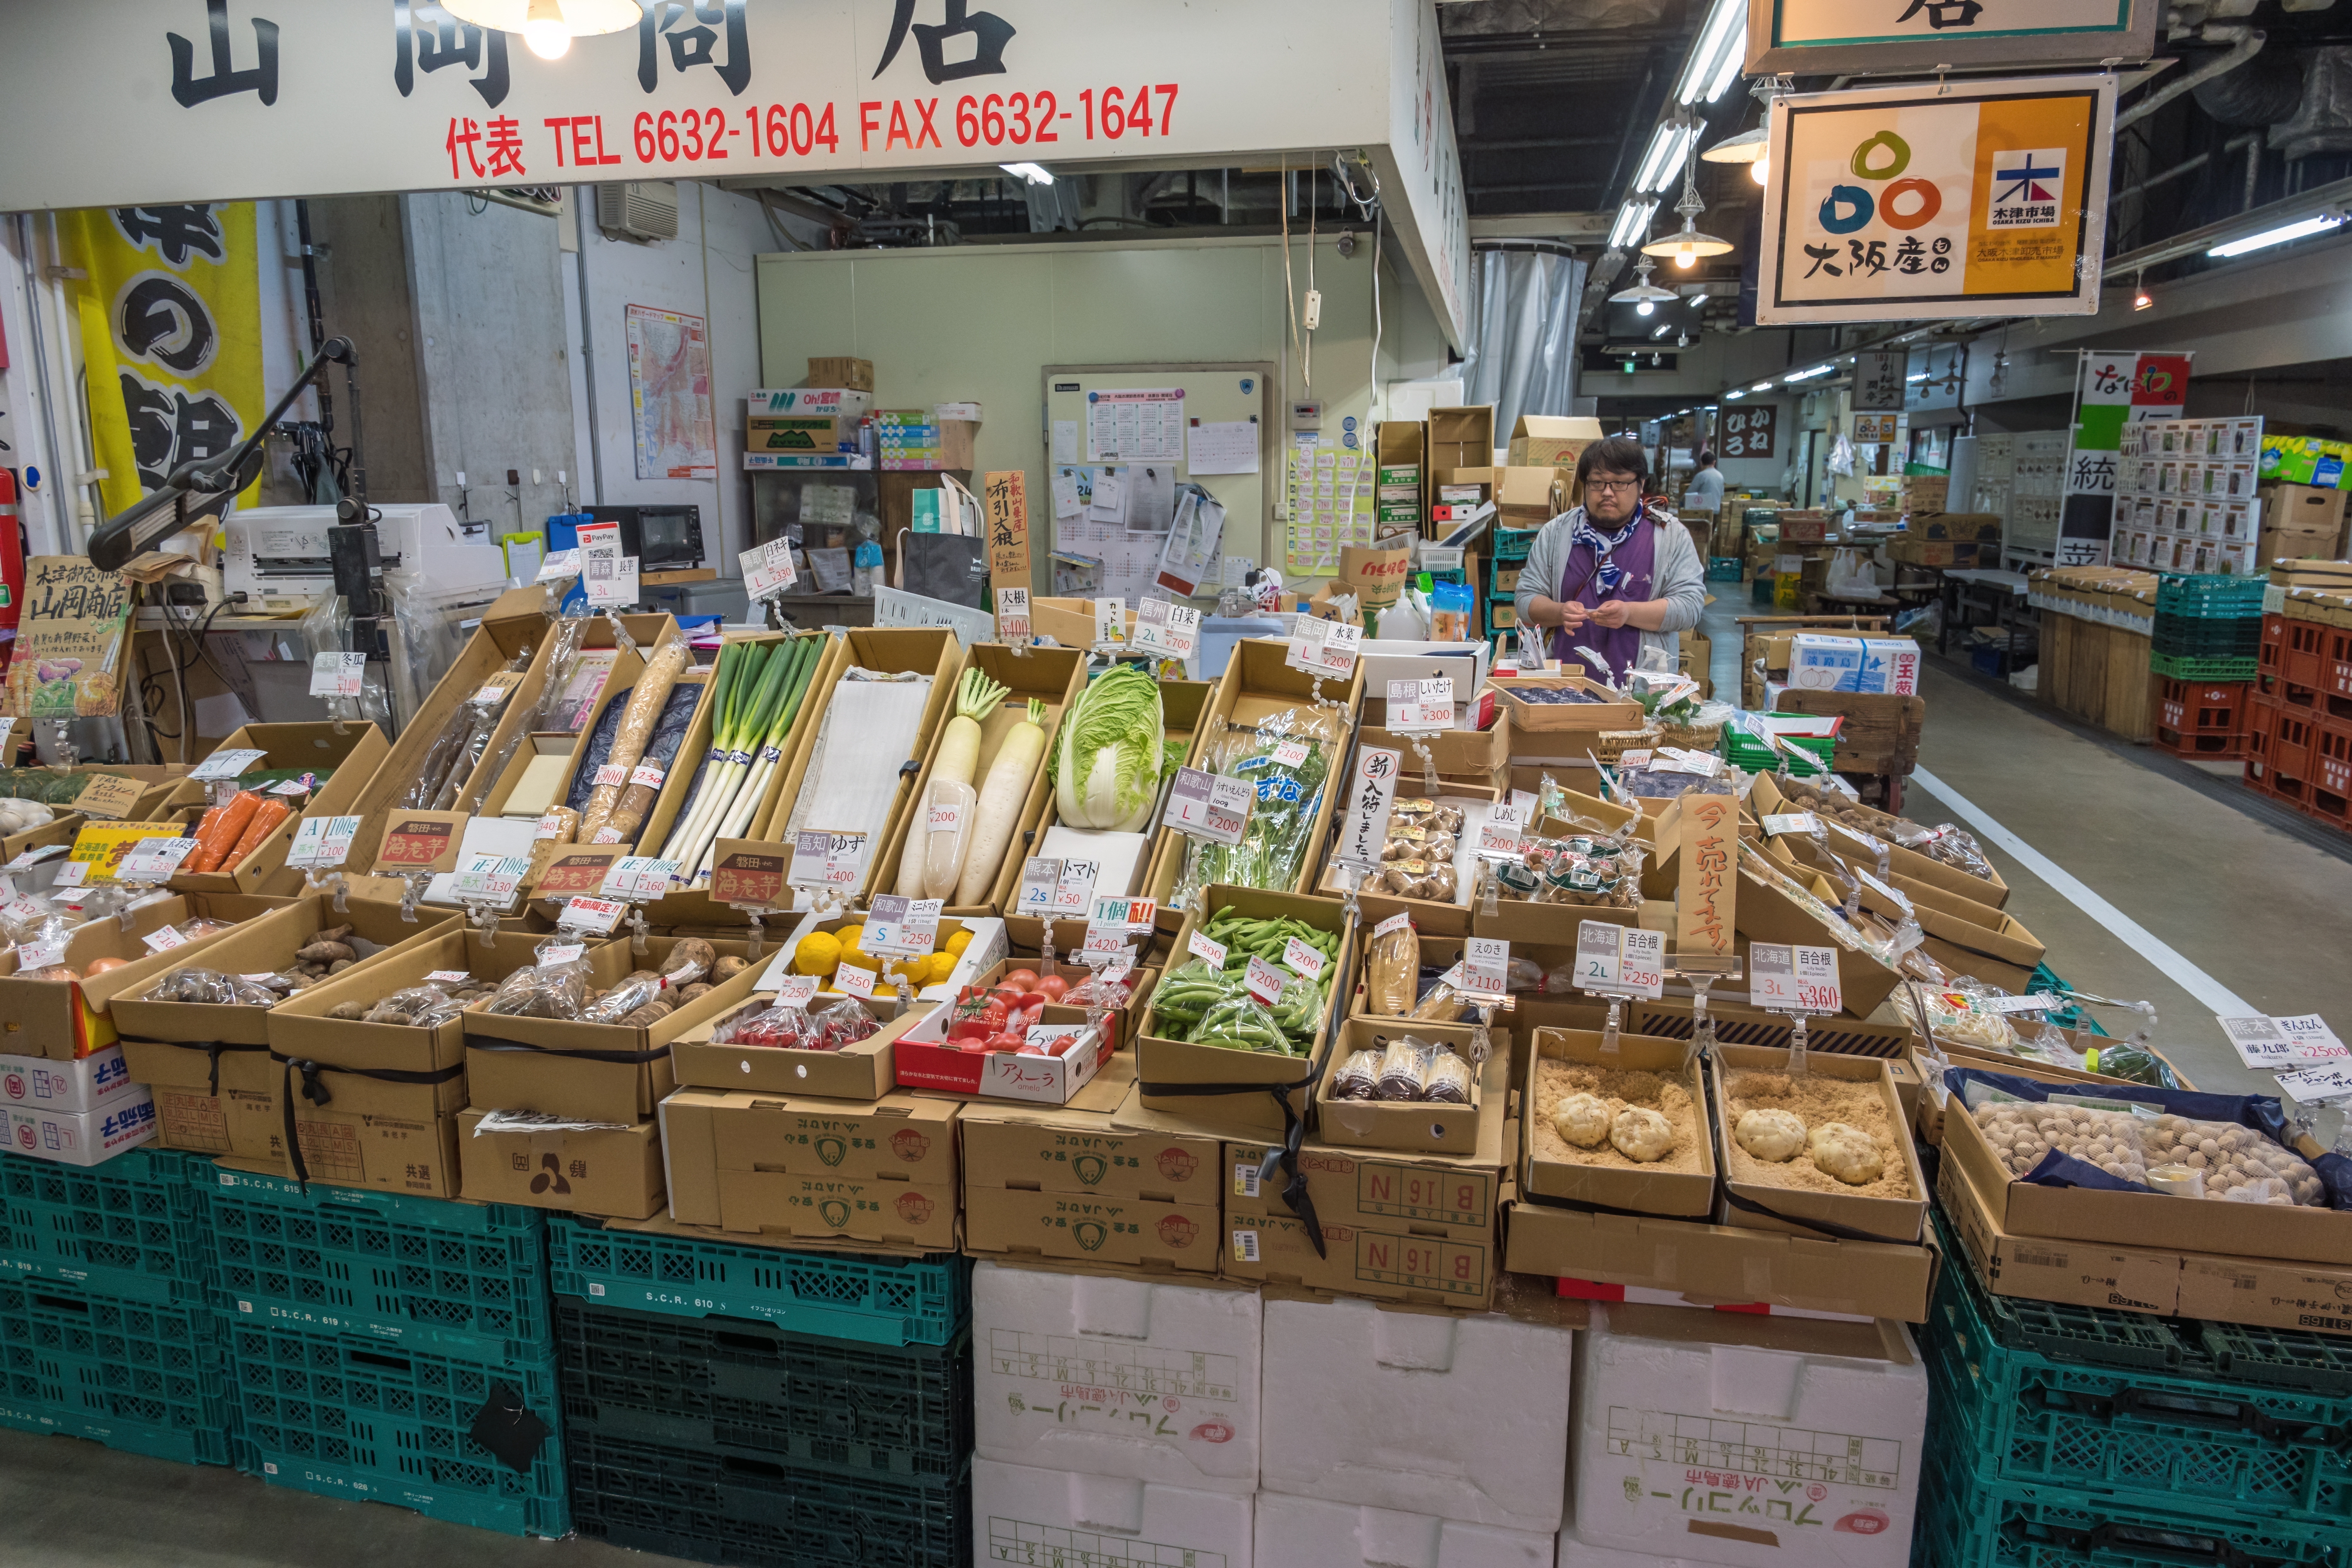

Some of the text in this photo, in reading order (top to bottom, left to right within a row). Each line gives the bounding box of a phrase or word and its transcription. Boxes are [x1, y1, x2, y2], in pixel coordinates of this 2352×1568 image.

[446, 84, 1178, 179] 代表 TEL 6632-1604 FAX 6632-1647
[1994, 205, 2055, 218] 木津市場
[1977, 246, 2064, 257] 大阪木津卸売市場
[2073, 456, 2116, 490] 統
[1008, 473, 1025, 533] 和歌山県産
[989, 479, 1023, 548] 布引大根
[766, 537, 787, 557] 白ネギ
[619, 560, 633, 572] 長芋
[743, 551, 763, 569] 鳥取
[590, 561, 611, 576] 青森
[597, 585, 608, 595] 3L
[755, 577, 763, 587] L
[31, 583, 126, 620] 山岡商店
[1001, 590, 1025, 604] 大根
[1142, 601, 1167, 620] 信州
[1171, 605, 1196, 625] 白菜
[1002, 620, 1030, 637] ¥400-
[1143, 628, 1156, 642] 2L
[1298, 617, 1326, 638] 福岡
[1334, 626, 1355, 640] 水菜
[1166, 638, 1192, 649] ¥700-
[342, 653, 364, 665] 冬瓜
[1302, 646, 1309, 659] L
[316, 655, 337, 668] 愛知
[1324, 656, 1353, 668] ¥200-
[1389, 682, 1417, 699] 島根
[1420, 680, 1452, 694] しいたけ
[1423, 708, 1453, 721] ¥300-
[1179, 771, 1211, 791] 和歌山
[1216, 781, 1251, 798] うすいえんどう
[1212, 798, 1229, 808] 100g
[1354, 755, 1389, 862] 新入荷しました。
[1182, 804, 1191, 820] L
[1494, 805, 1518, 822] しめじ
[328, 817, 358, 838] 100g
[1207, 816, 1242, 834] ¥200-
[75, 843, 109, 852] 北海道産
[166, 838, 198, 849] 玉ねぎ
[386, 836, 447, 860] 海老芋
[798, 834, 826, 851] 高知
[831, 835, 866, 854] ゆず
[1482, 836, 1516, 850] ¥200-
[321, 846, 347, 856] ¥100-
[827, 871, 857, 882] ¥400-
[1026, 860, 1056, 877] 熊本
[1062, 859, 1096, 879] トマト
[485, 882, 513, 893] ¥130-
[638, 881, 667, 891] ¥160-
[875, 898, 906, 914] 和歌山
[910, 900, 938, 912] ミニトマト
[1058, 893, 1083, 904] ¥50-
[1096, 901, 1129, 921] 1個
[875, 928, 888, 941] S
[901, 933, 935, 945] ¥250-
[1582, 928, 1617, 945] 北海道
[1627, 933, 1658, 950] 百合根
[1087, 939, 1121, 951] ¥420-
[1193, 940, 1224, 960] ¥300-
[1474, 942, 1502, 955] えのき
[1288, 948, 1321, 972] ¥200-
[1625, 953, 1652, 961] 1個(1piece)
[1754, 948, 1791, 966] 北海道
[1799, 951, 1832, 967] 百合根
[1589, 961, 1608, 978] 2L
[1249, 970, 1283, 992] ¥200-
[1466, 975, 1504, 991] ¥110-
[1624, 971, 1662, 987] ¥250-
[1764, 979, 1785, 996] 3L
[1798, 985, 1842, 1009] ¥360-
[954, 1006, 1039, 1026] おいしさに、感動を
[2227, 1018, 2272, 1034] 熊本
[2280, 1018, 2322, 1031] ぎんなん
[2245, 1044, 2289, 1054] 藤九郎
[1001, 1063, 1054, 1087] アメーラ
[2277, 1070, 2317, 1081] スーパー
[2302, 1072, 2343, 1084] ジャンボ
[1018, 1084, 1040, 1092] amela
[406, 1163, 431, 1181] 共選
[243, 1178, 300, 1194] S.C.R. 615
[1371, 1174, 1391, 1200] N
[1409, 1180, 1434, 1205] 16
[1457, 1185, 1474, 1210] B
[646, 1292, 713, 1308] S.C.R. 610
[1651, 1488, 1823, 1526] ブロッコリー
